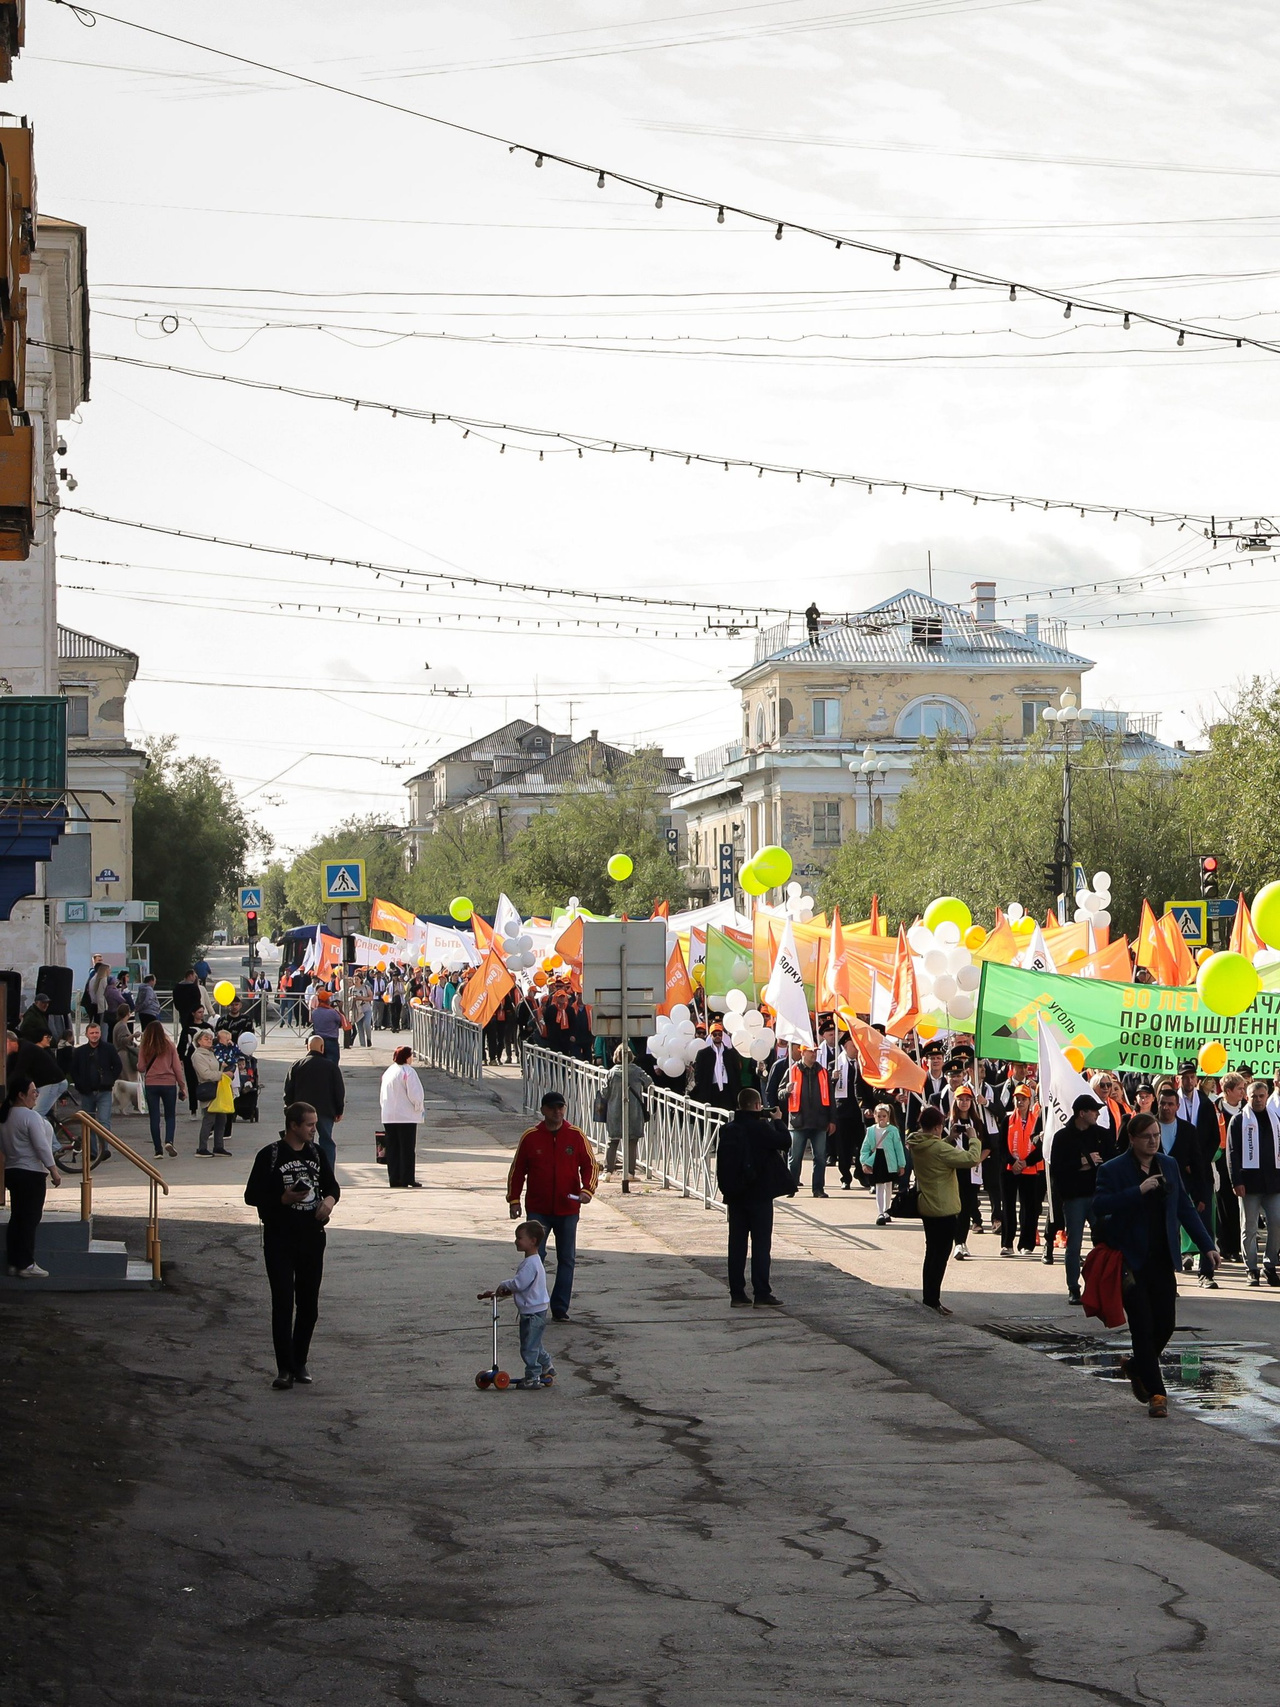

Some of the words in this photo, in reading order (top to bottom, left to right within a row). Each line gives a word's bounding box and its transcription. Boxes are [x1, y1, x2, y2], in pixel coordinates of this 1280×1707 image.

[722, 845, 732, 898] ОКНА
[435, 937, 461, 949] Быть
[1122, 988, 1151, 1009] 90
[1157, 990, 1199, 1012] ЛЕТ
[1048, 1001, 1077, 1034] УГОЛЬ
[1120, 1031, 1206, 1050] ОСВОЕНИЯ
